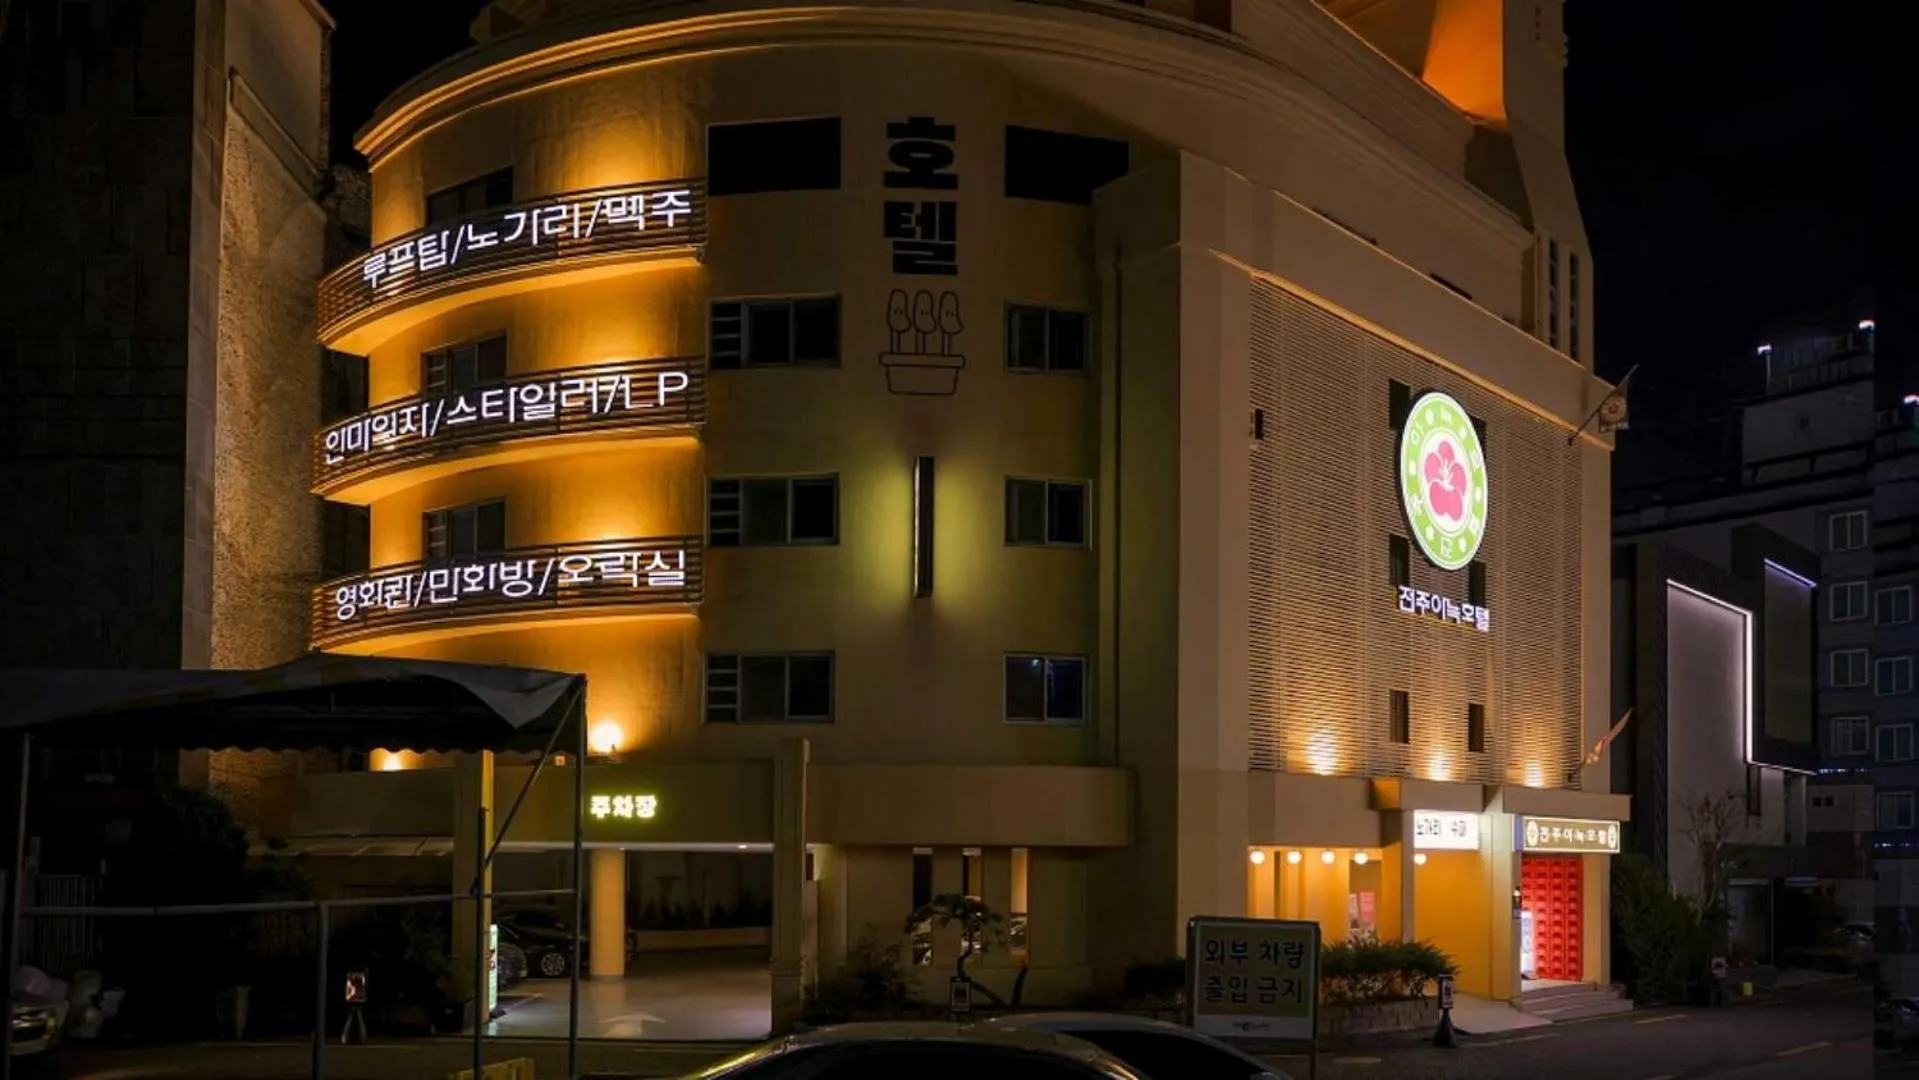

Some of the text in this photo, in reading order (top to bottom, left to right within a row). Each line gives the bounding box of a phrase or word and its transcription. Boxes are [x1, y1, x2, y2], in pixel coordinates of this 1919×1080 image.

[883, 116, 959, 276] 호텔
[590, 794, 658, 820] 주차장
[1205, 939, 1305, 969] 외부 차량
[1205, 975, 1303, 1004] 출입 금지
